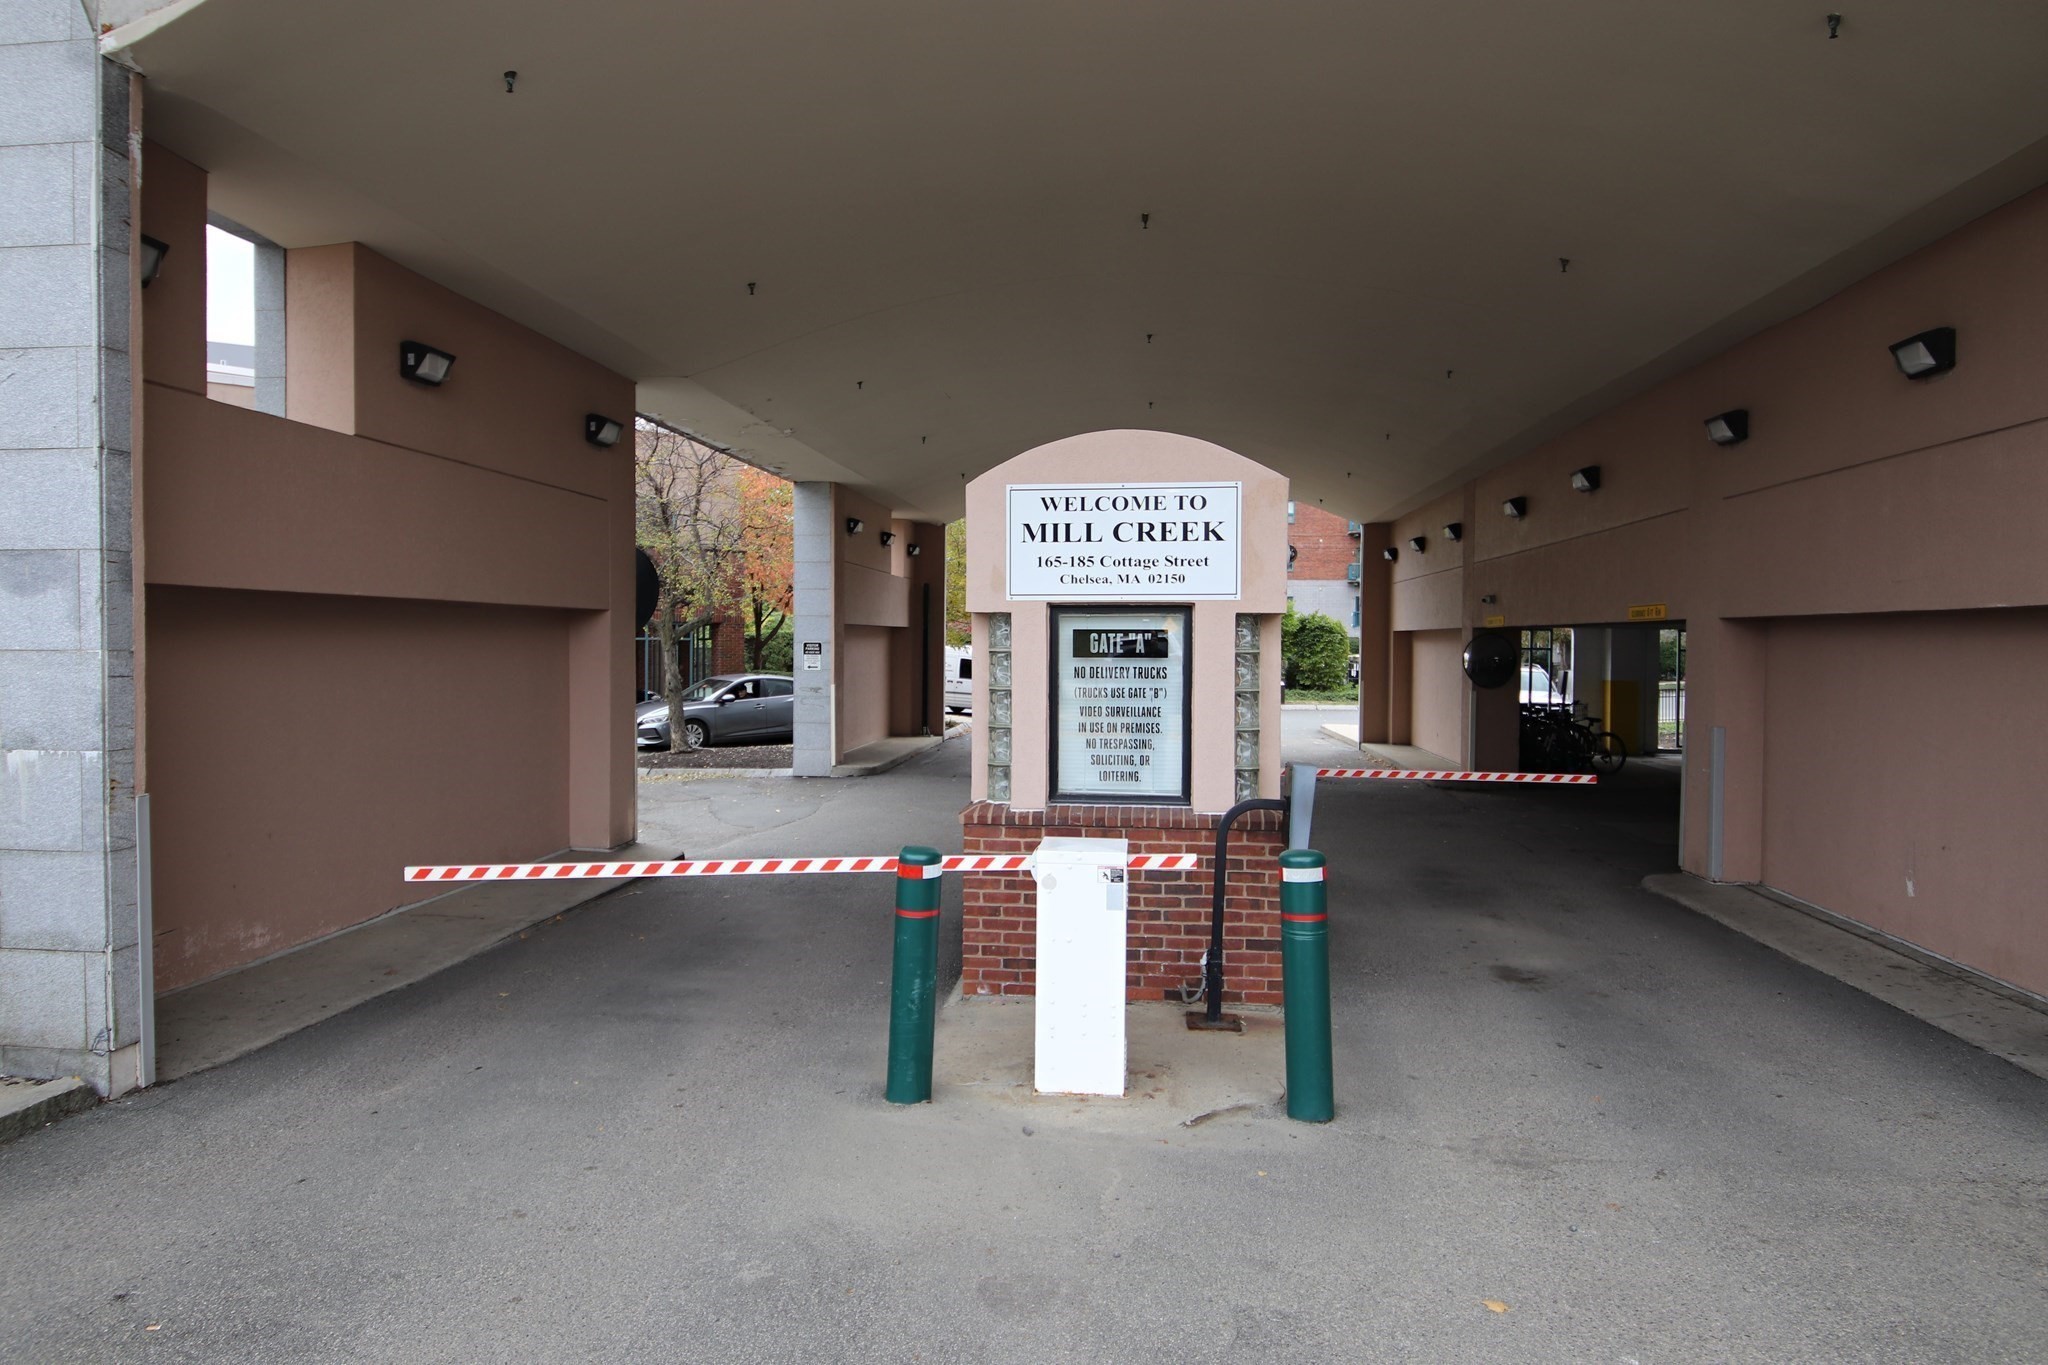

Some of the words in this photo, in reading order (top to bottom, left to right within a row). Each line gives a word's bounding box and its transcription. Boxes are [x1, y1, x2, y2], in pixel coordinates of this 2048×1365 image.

[1041, 495, 1167, 512] WELCOME
[1174, 495, 1207, 511] TO
[1021, 522, 1103, 543] MILL
[1113, 521, 1225, 542] CREEK
[1037, 555, 1095, 568] 165-185
[1100, 555, 1159, 570] Cottage
[1165, 555, 1209, 567] Street
[1060, 574, 1113, 585] Chelsea,
[1117, 574, 1140, 584] MA
[1148, 573, 1185, 584] 02150
[1089, 632, 1123, 653] GATE
[1128, 632, 1152, 653] "A"
[1074, 667, 1086, 679] NO
[1089, 667, 1130, 679] DELIVERY
[1133, 667, 1167, 679] TRUCKS
[1074, 688, 1108, 699] (TRUCKS
[1111, 688, 1125, 698] USE
[1128, 688, 1146, 698] GATE
[1080, 706, 1102, 717] VIDEO
[1105, 706, 1162, 718] SURVEILLANCE
[1078, 722, 1087, 733] IN
[1090, 722, 1104, 733] USE
[1107, 723, 1118, 733] ON
[1120, 723, 1162, 734] PREMISES.
[1086, 739, 1096, 749] NO
[1099, 739, 1155, 751] TRESPASSING,
[1091, 755, 1137, 766] SOLICITING,
[1140, 755, 1150, 766] OR
[1099, 771, 1142, 782] LOITERING.
